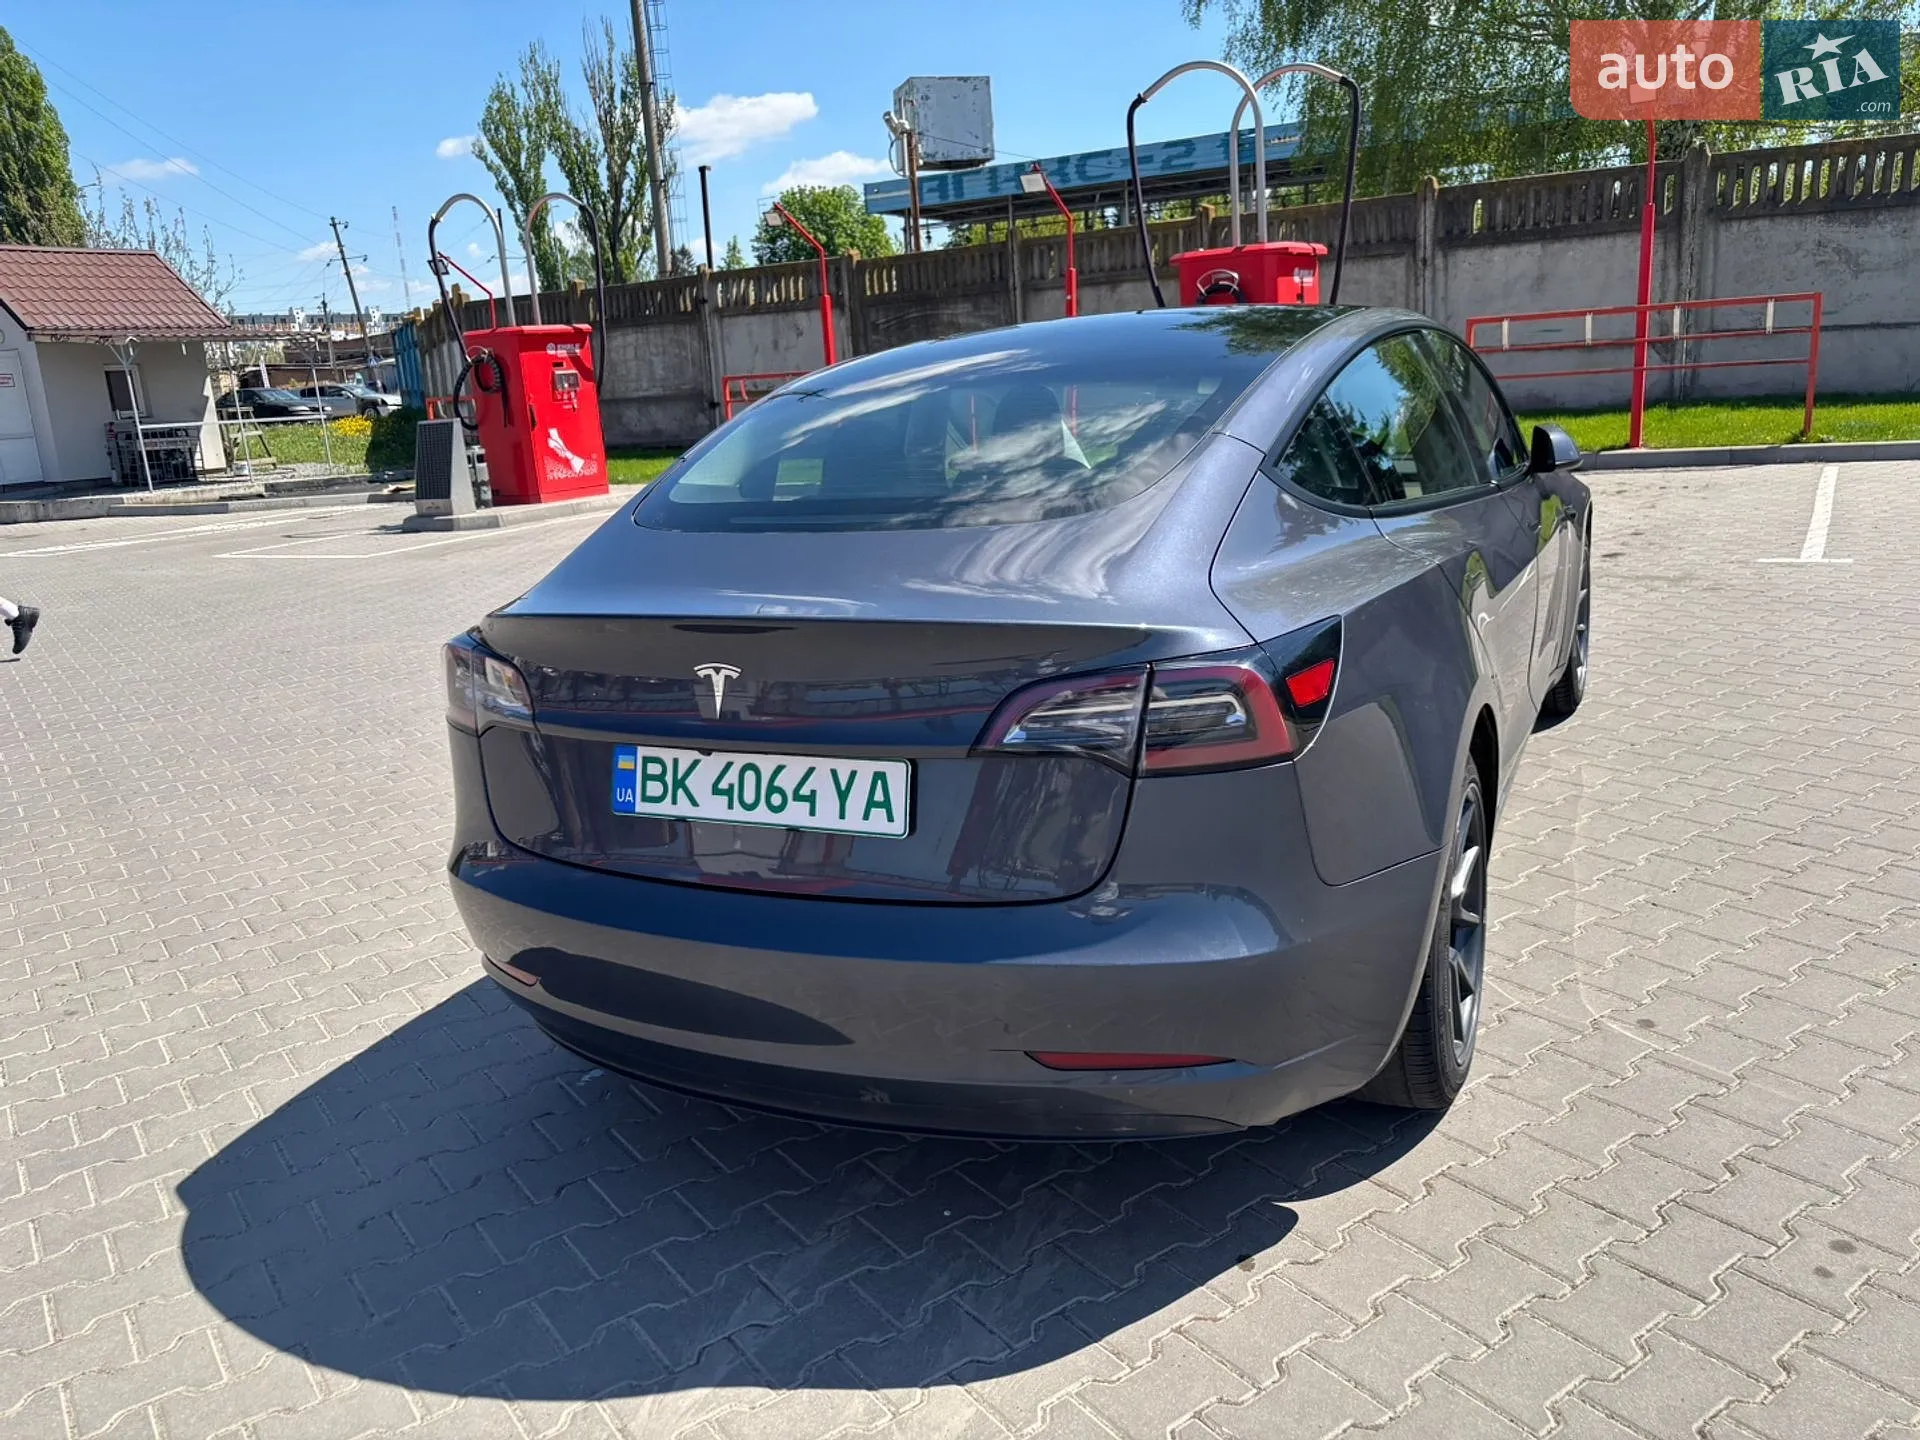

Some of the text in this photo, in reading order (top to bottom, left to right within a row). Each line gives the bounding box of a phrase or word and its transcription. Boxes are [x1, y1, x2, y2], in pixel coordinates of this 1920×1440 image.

[616, 787, 634, 803] UA
[640, 755, 895, 823] BK 4064 YA
